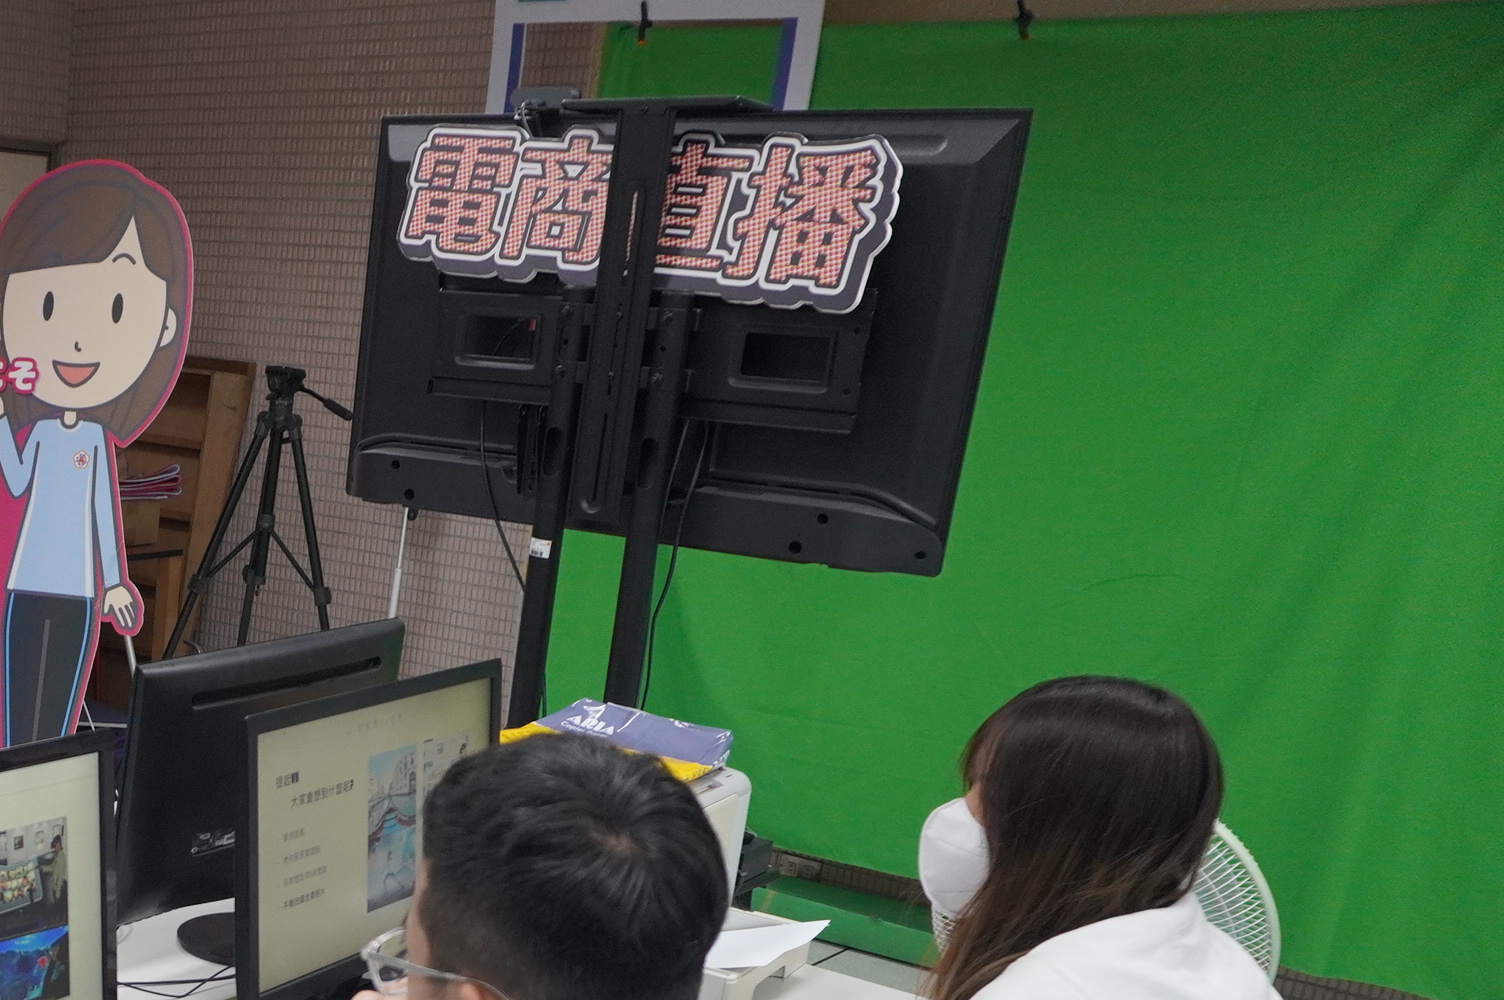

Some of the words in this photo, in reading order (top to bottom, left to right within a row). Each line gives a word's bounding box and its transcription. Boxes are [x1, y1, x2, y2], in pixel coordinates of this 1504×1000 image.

[406, 128, 879, 287] 電商直播
[566, 715, 614, 735] ARIA
